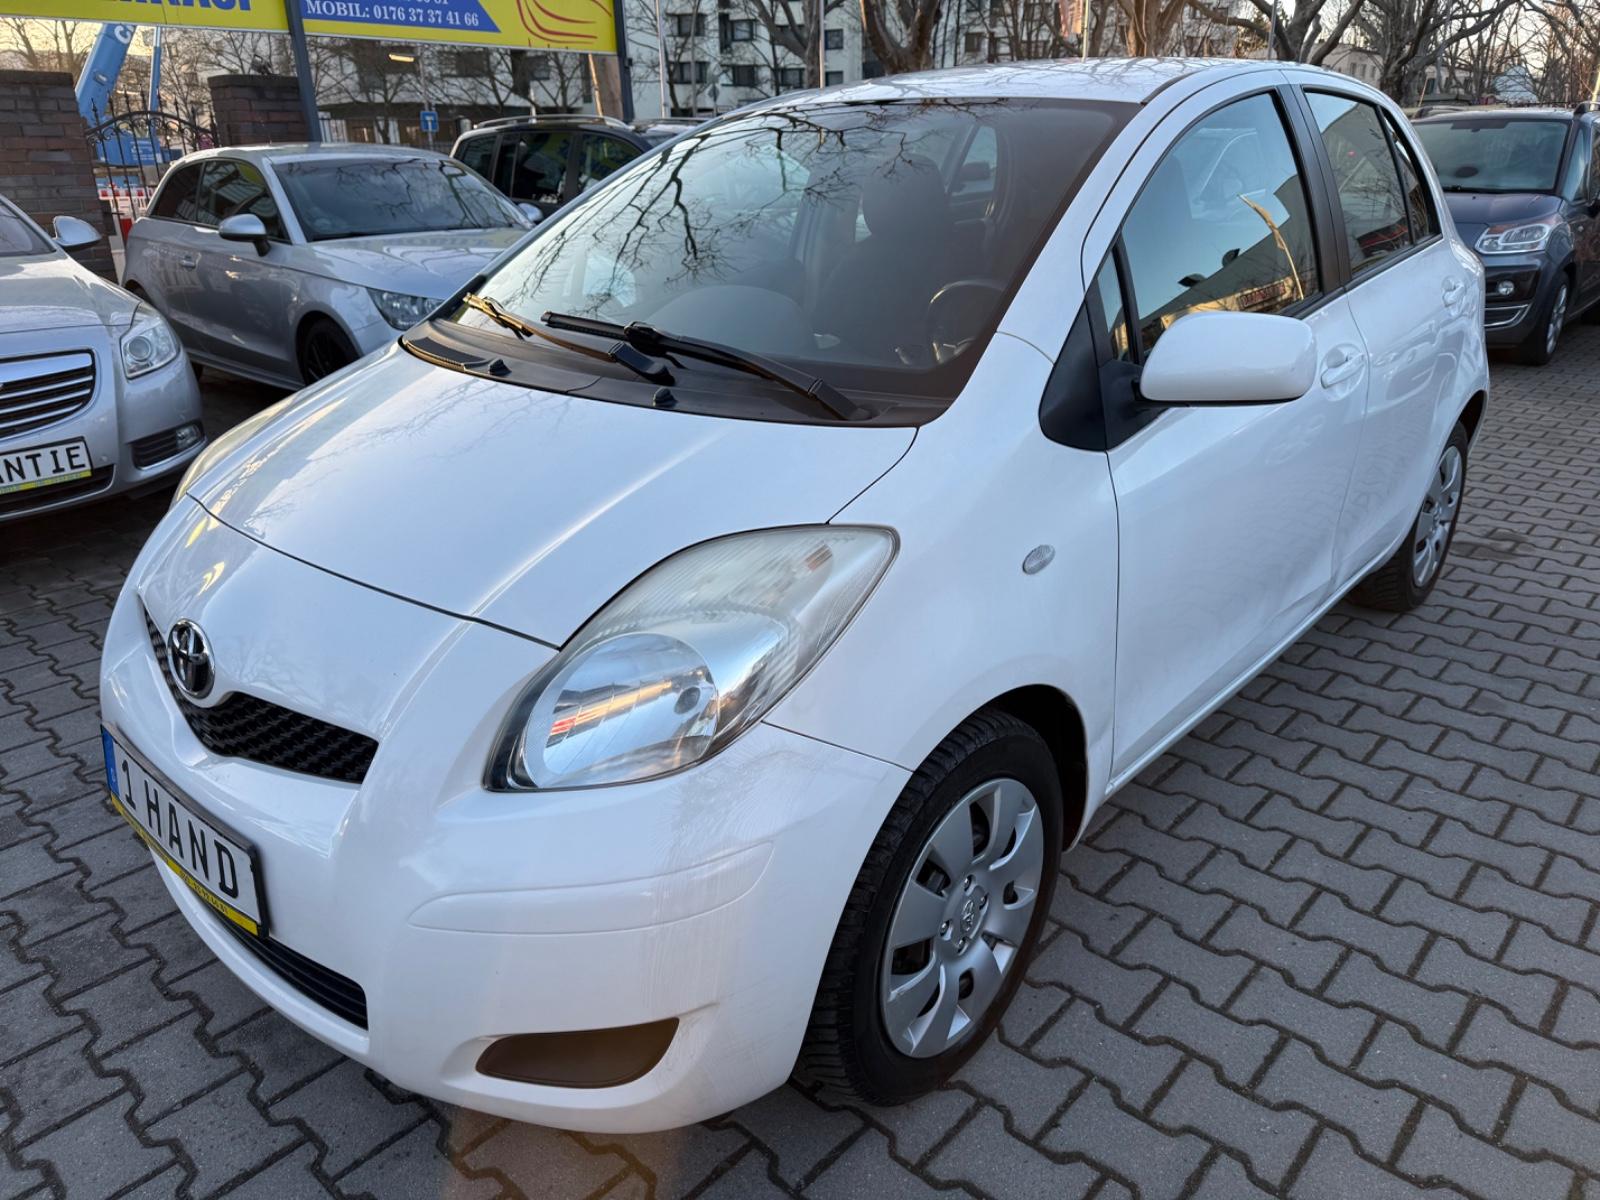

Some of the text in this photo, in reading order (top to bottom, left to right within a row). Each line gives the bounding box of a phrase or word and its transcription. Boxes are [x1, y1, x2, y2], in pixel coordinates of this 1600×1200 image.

[306, 0, 479, 27] MOBIL: 0176 37 37 41 66
[0, 446, 86, 484] NTIE
[121, 759, 136, 811] 1
[144, 779, 240, 898] HAND
